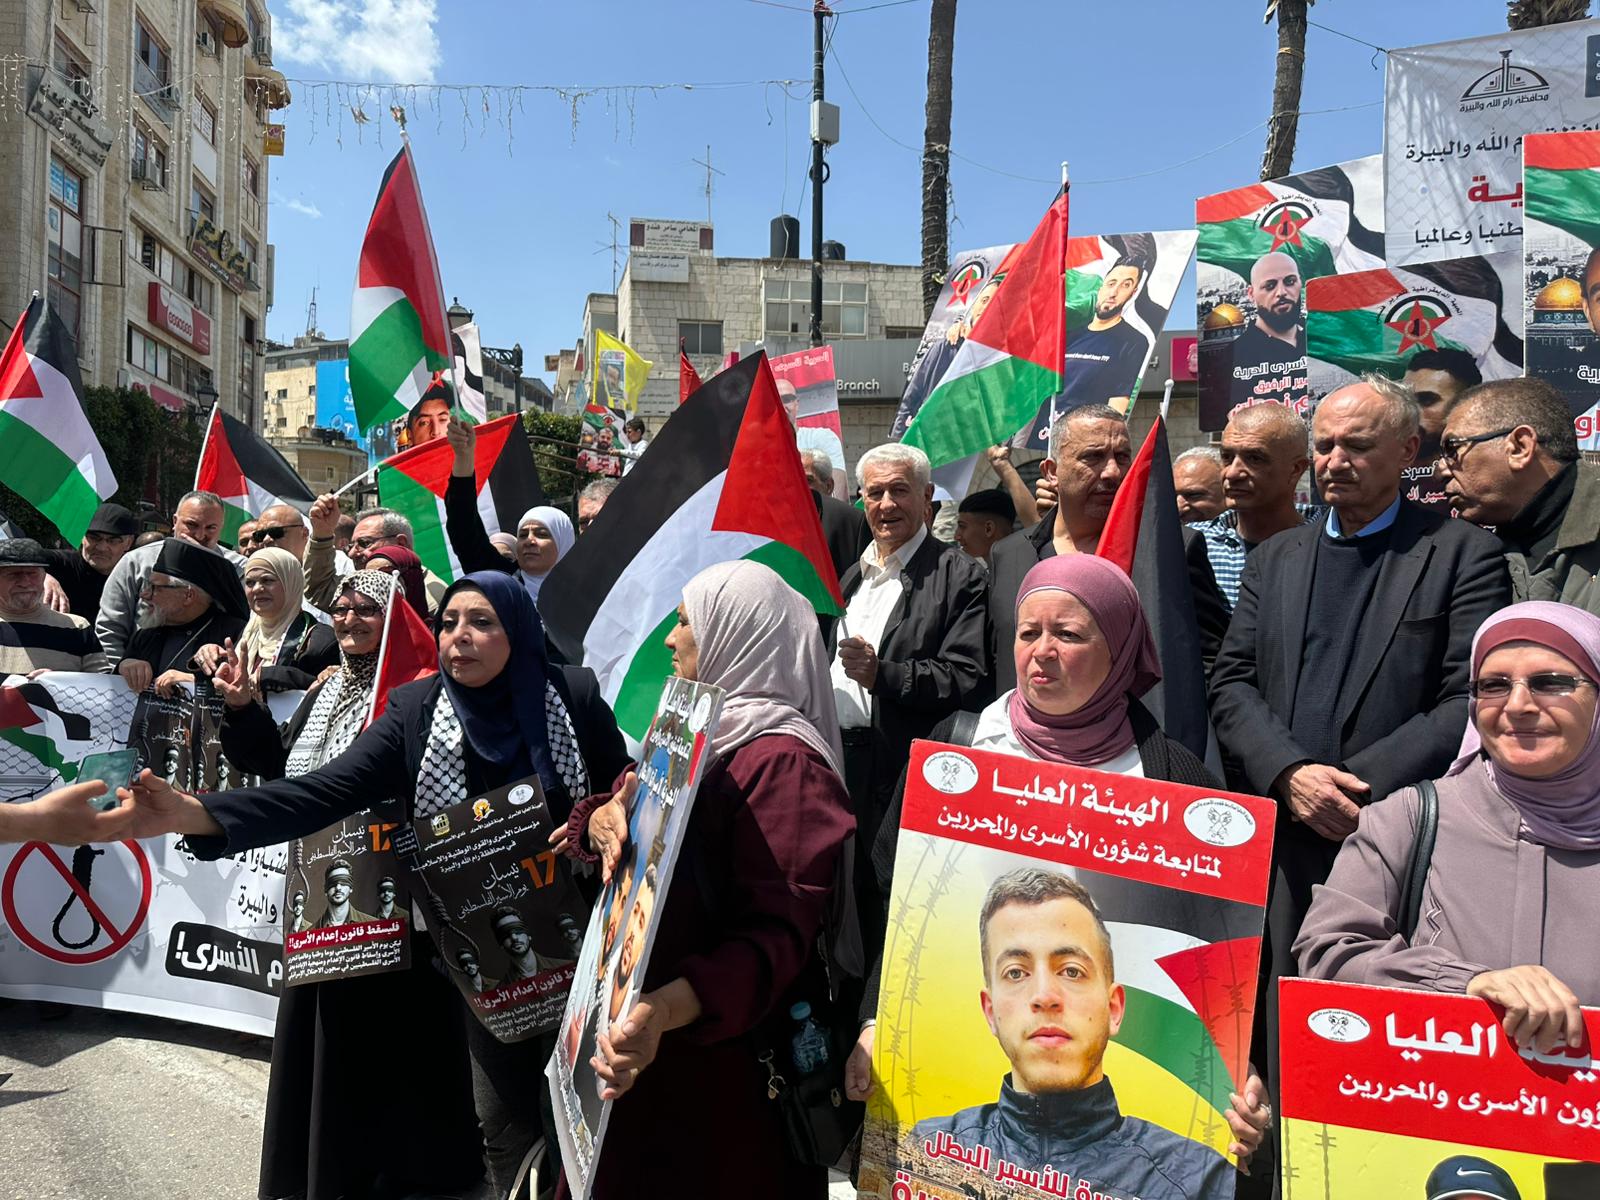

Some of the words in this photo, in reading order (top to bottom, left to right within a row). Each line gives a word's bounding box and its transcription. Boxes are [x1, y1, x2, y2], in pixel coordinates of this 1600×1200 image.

[1459, 100, 1484, 113] والبيرة
[1486, 98, 1500, 109] الله
[1501, 97, 1514, 110] رام
[1514, 92, 1549, 105] محافظة
[1405, 138, 1471, 163] والبيرة
[1475, 127, 1508, 152] الله
[1232, 362, 1269, 381] الحرية
[836, 378, 880, 392] Branch
[991, 768, 1077, 807] العليا
[1081, 780, 1170, 828] الهيئة
[331, 820, 366, 844] نيسان
[936, 804, 1018, 841] والمحررين
[1020, 822, 1090, 851] الأسرى
[1092, 834, 1151, 865] شؤون
[481, 861, 520, 890] نيسان
[521, 850, 557, 889] 17
[1153, 844, 1223, 880] لمتابعة
[237, 884, 278, 924] والبيرة
[315, 930, 339, 945] إعدام
[340, 927, 365, 941] قانون
[366, 921, 400, 935] فليسقط
[175, 930, 260, 976] الأسرى!
[511, 981, 540, 1001] إعدام
[539, 972, 564, 991] قانون
[1384, 1011, 1498, 1063] العليا
[1337, 1073, 1449, 1109] والمحررين
[1456, 1088, 1547, 1116] الأسرى
[924, 1130, 992, 1172] البطل
[994, 1157, 1070, 1199] للأسير
